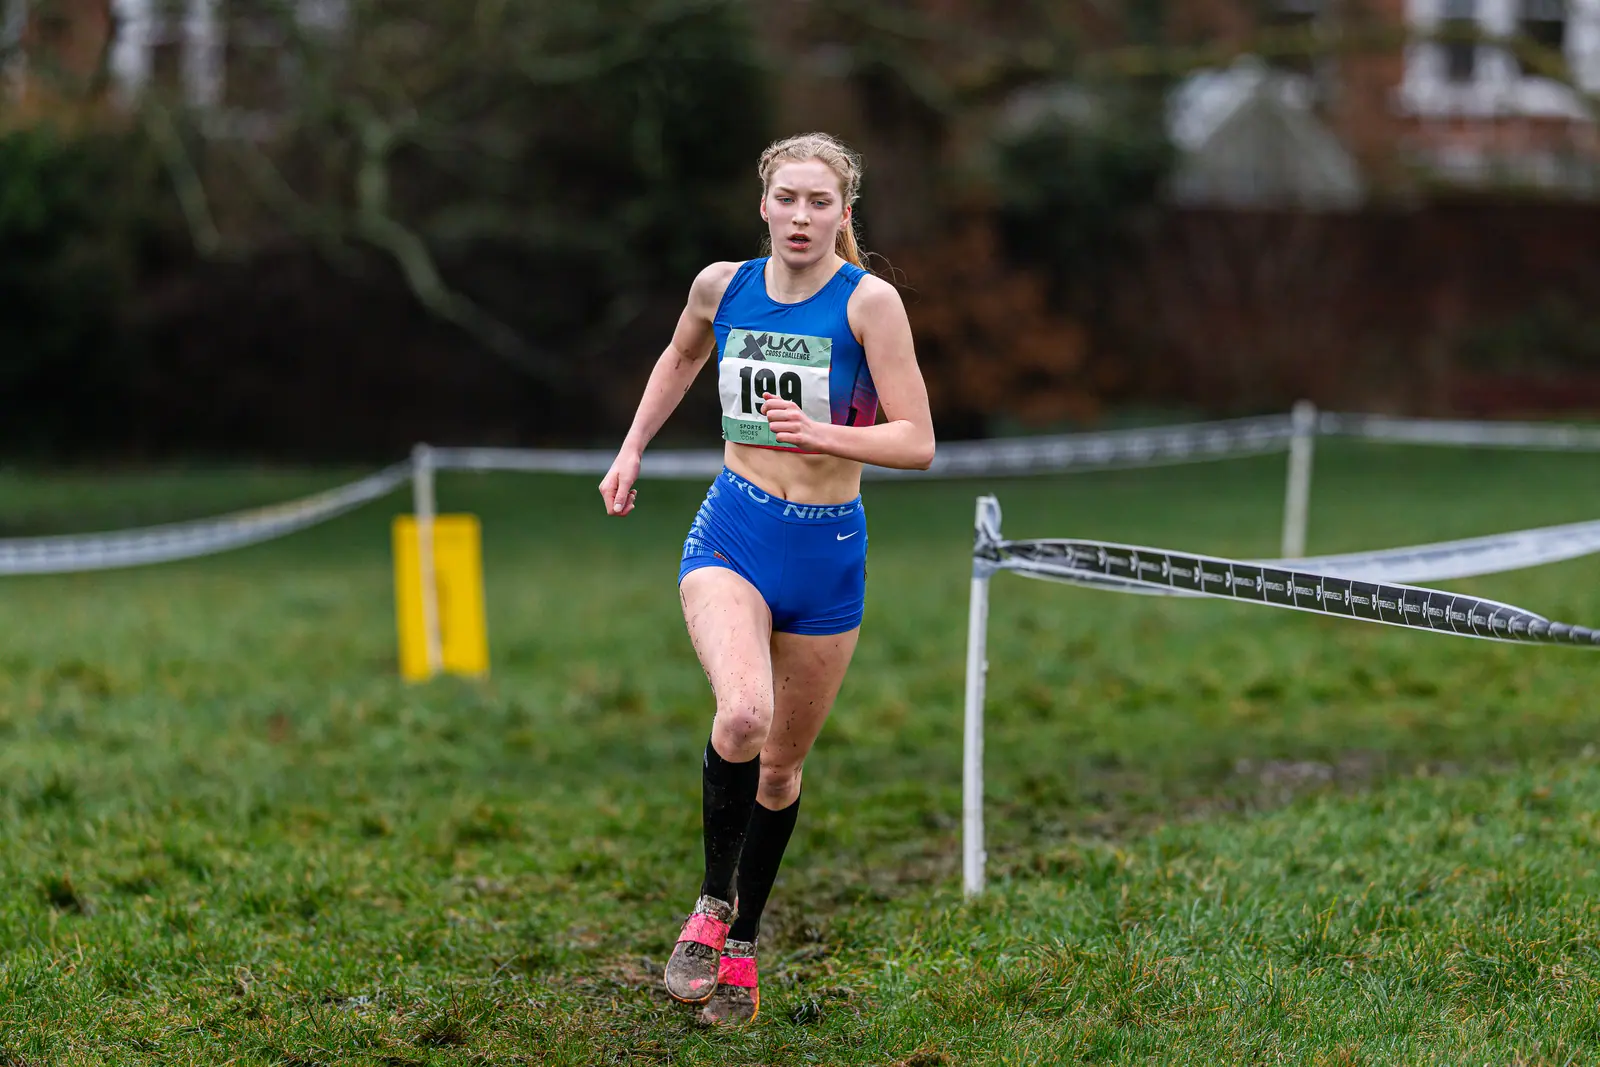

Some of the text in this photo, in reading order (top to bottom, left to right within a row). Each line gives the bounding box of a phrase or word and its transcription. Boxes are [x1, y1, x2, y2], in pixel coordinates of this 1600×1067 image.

[767, 335, 810, 354] UKA
[765, 349, 811, 361] CROSS CHALLENGE
[739, 366, 803, 417] 199
[739, 423, 762, 431] SPORTS
[739, 429, 759, 437] SHOES
